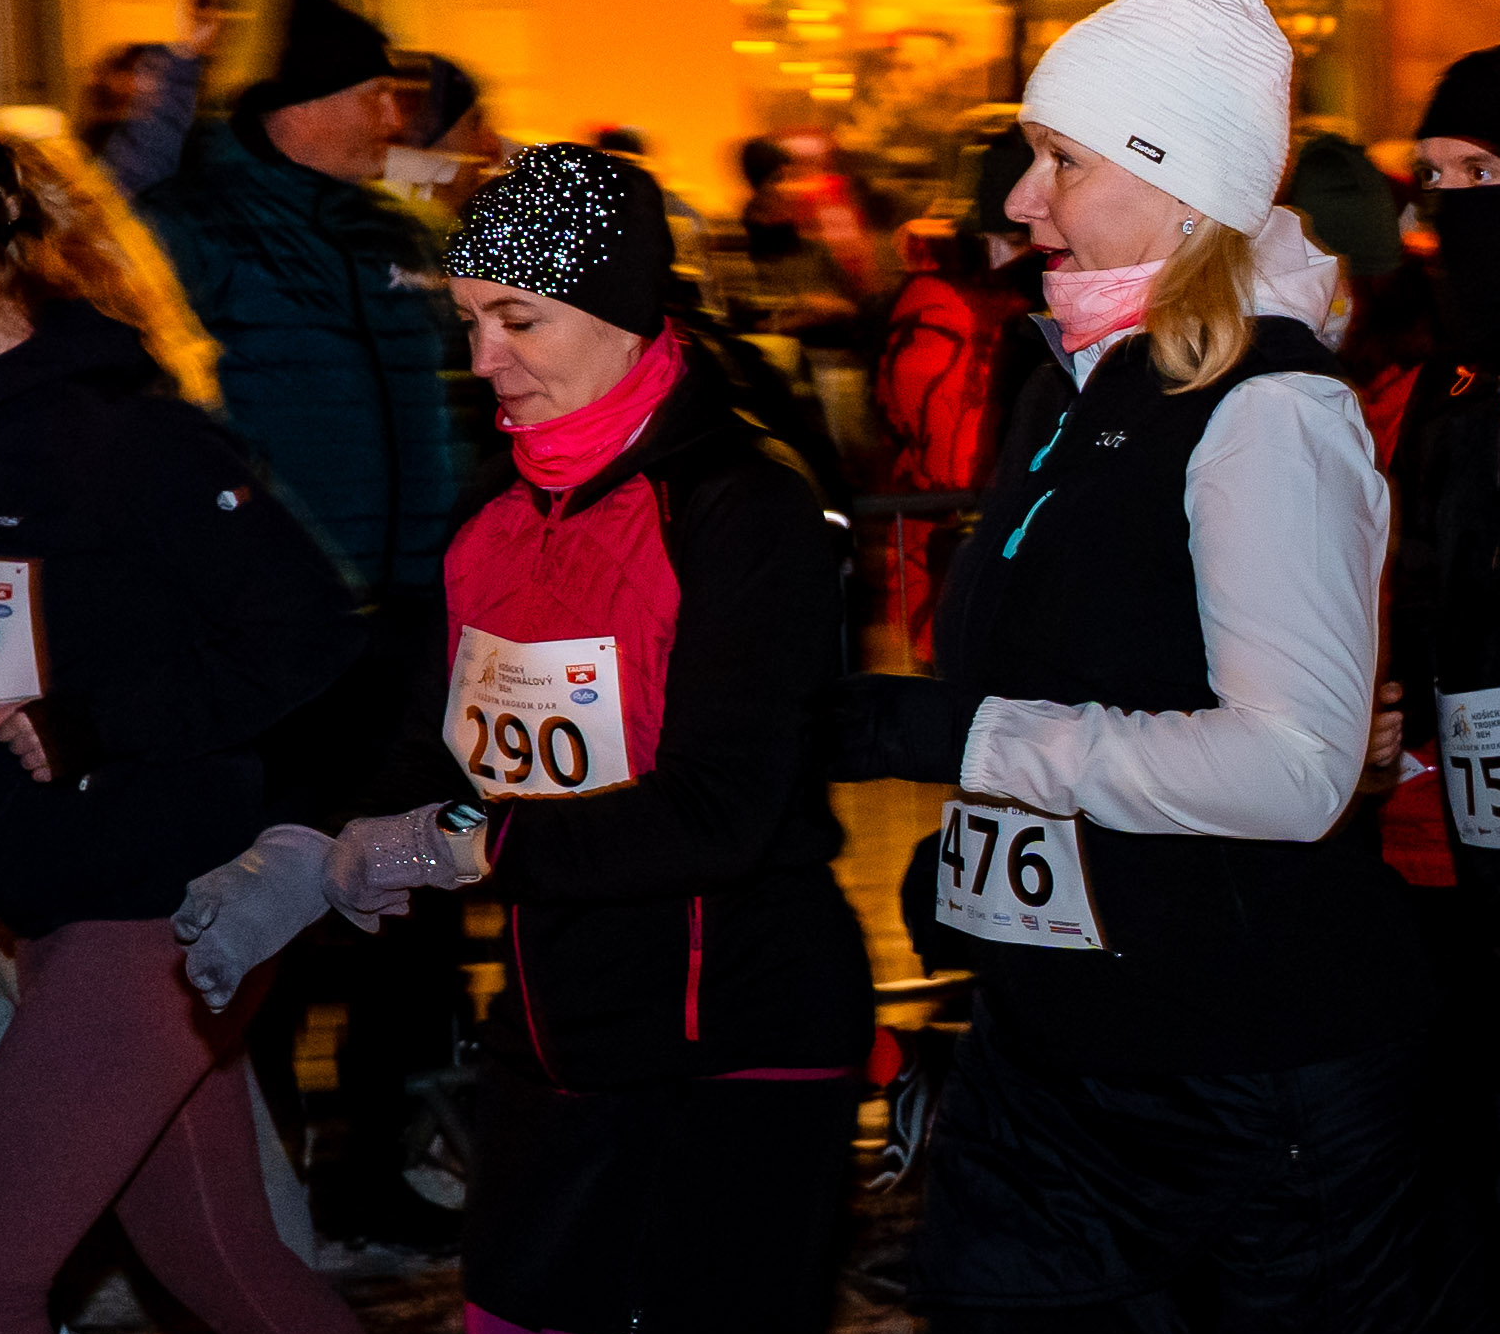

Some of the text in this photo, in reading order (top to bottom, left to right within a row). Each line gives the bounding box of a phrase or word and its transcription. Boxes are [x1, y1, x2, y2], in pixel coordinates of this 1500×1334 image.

[466, 704, 589, 788] 290
[537, 702, 557, 710] DAR
[941, 807, 1054, 908] 476
